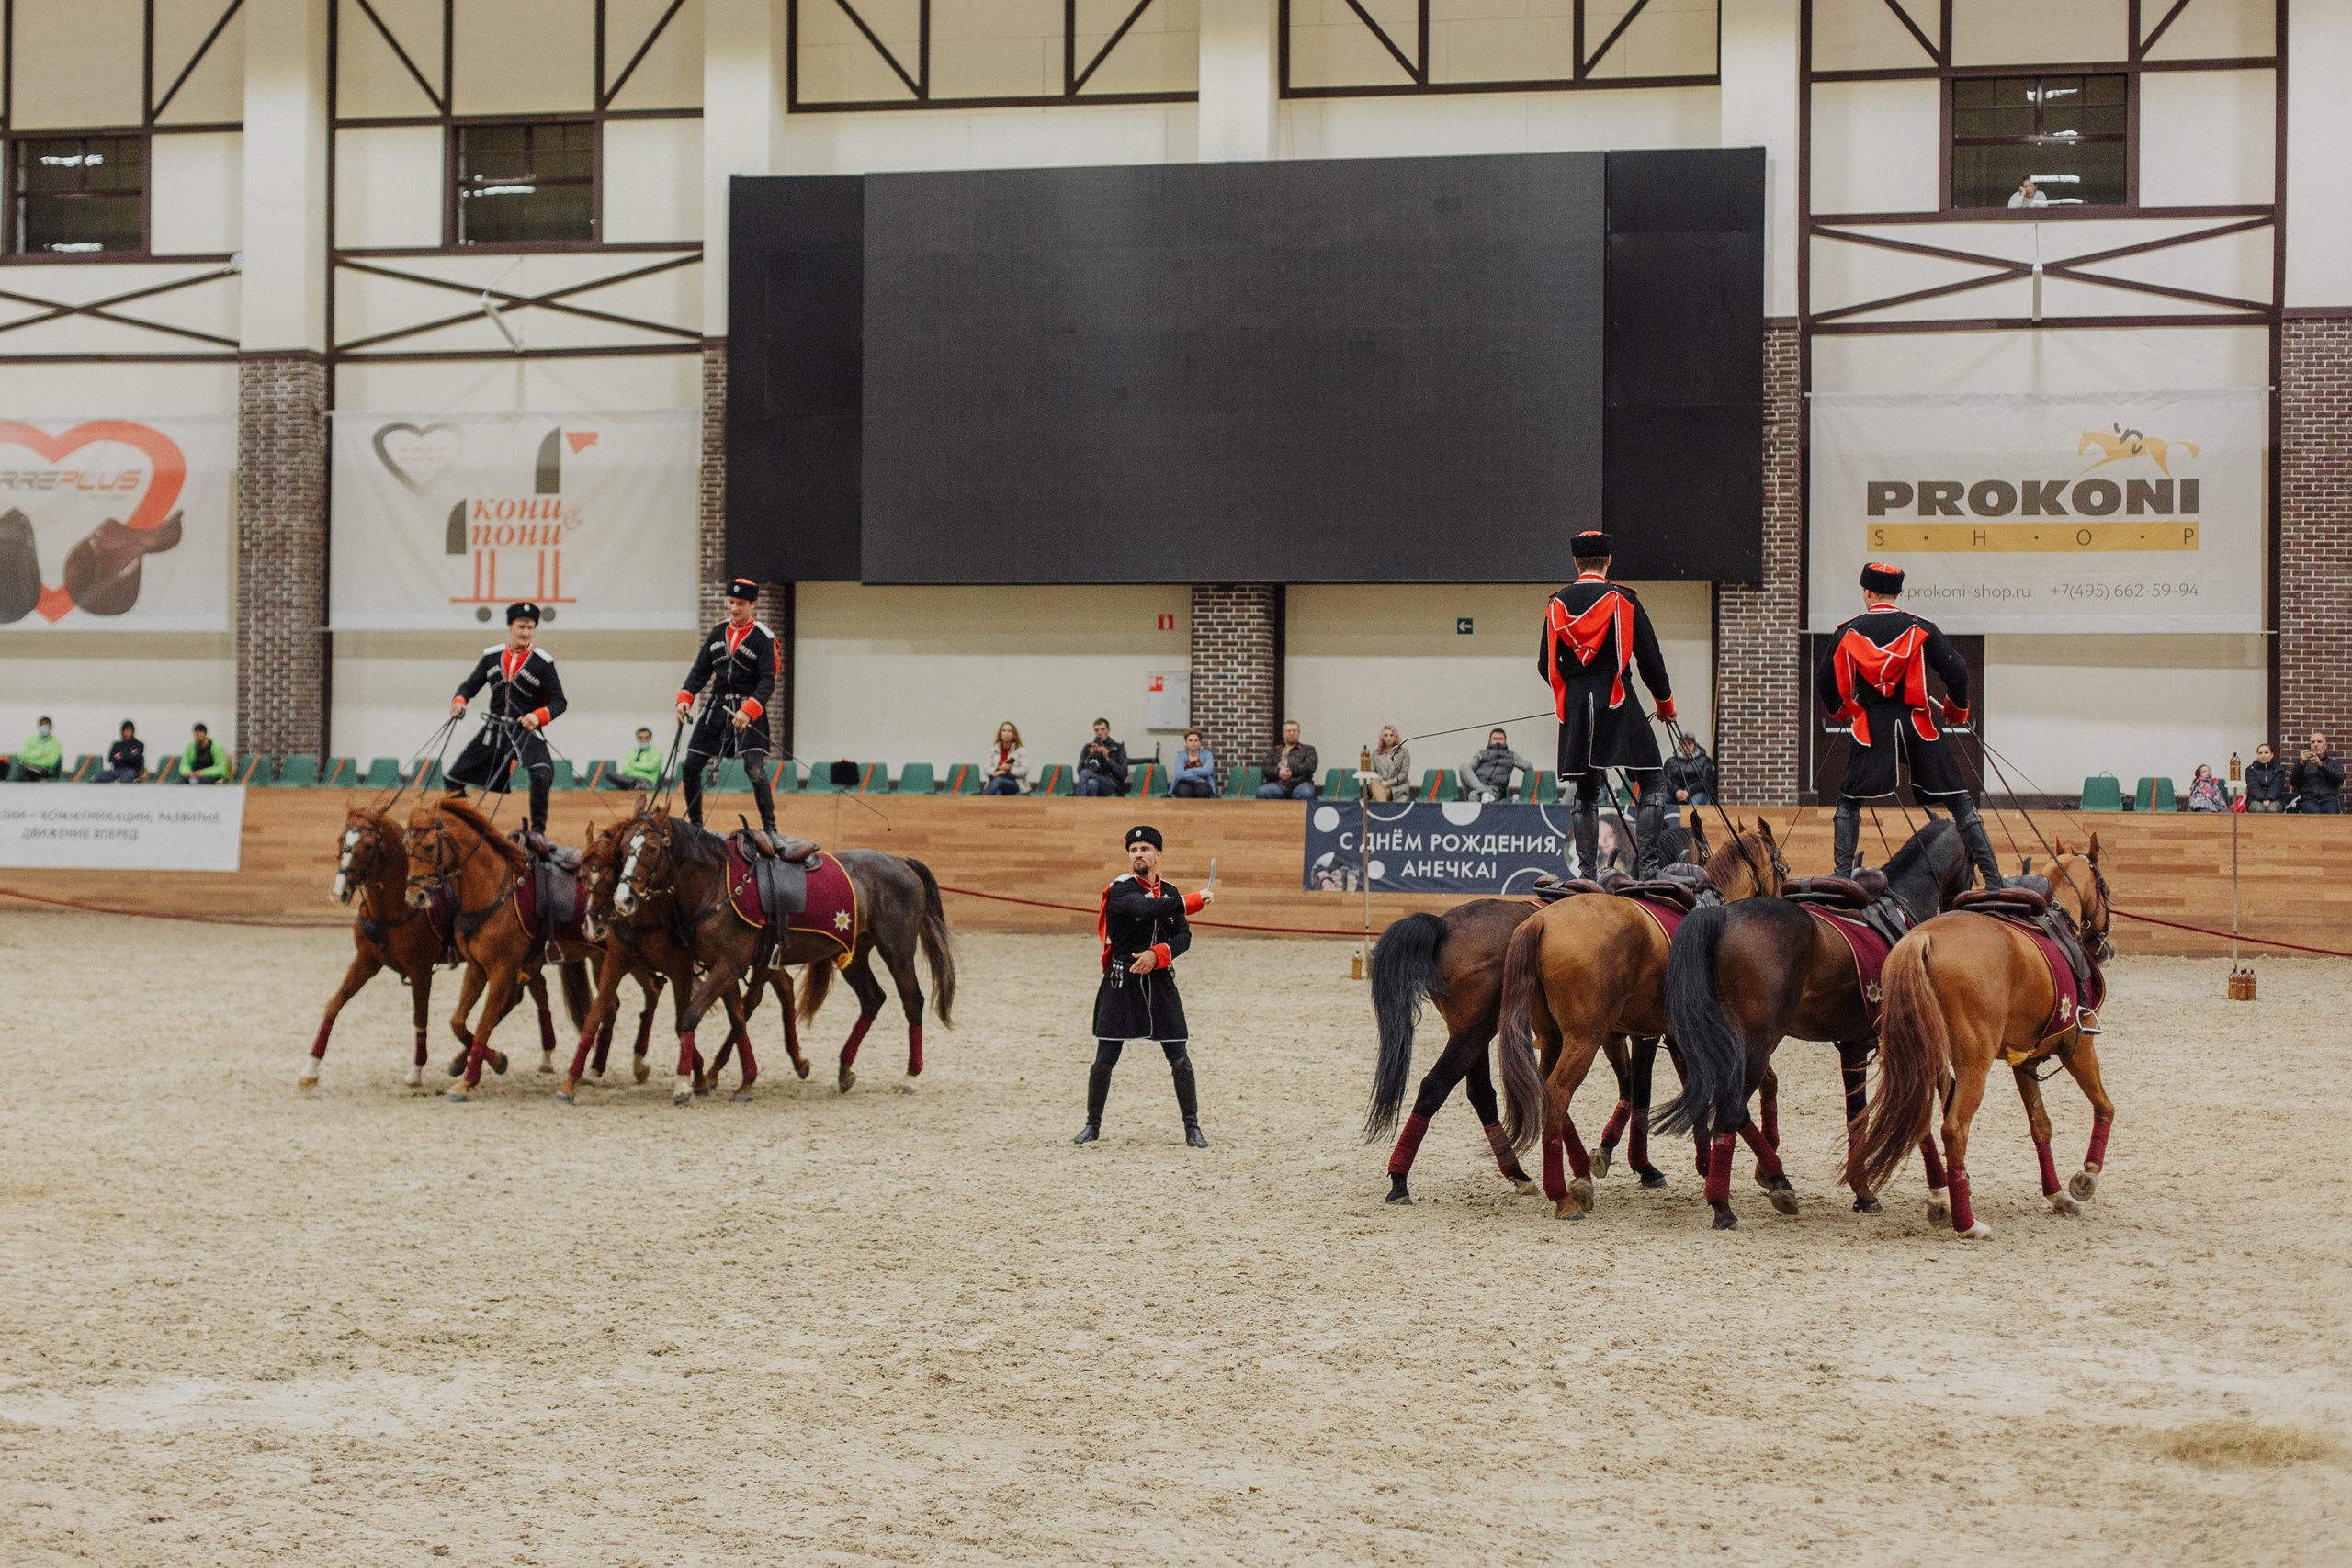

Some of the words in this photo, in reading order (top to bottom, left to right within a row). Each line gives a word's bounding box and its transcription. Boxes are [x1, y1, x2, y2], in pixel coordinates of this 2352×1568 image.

[1867, 479, 2199, 516] PROKONI
[2051, 582, 2109, 601] +7(495)
[2113, 582, 2199, 598] 662-59-94
[21, 827, 90, 840] ДВИЖЕНИЕ
[1339, 831, 1353, 851] С
[1359, 829, 1423, 853] ДНЁМ
[1430, 833, 1562, 856] РОЖДЕНИЯ,
[1400, 859, 1497, 879] АНЕЧКА!
